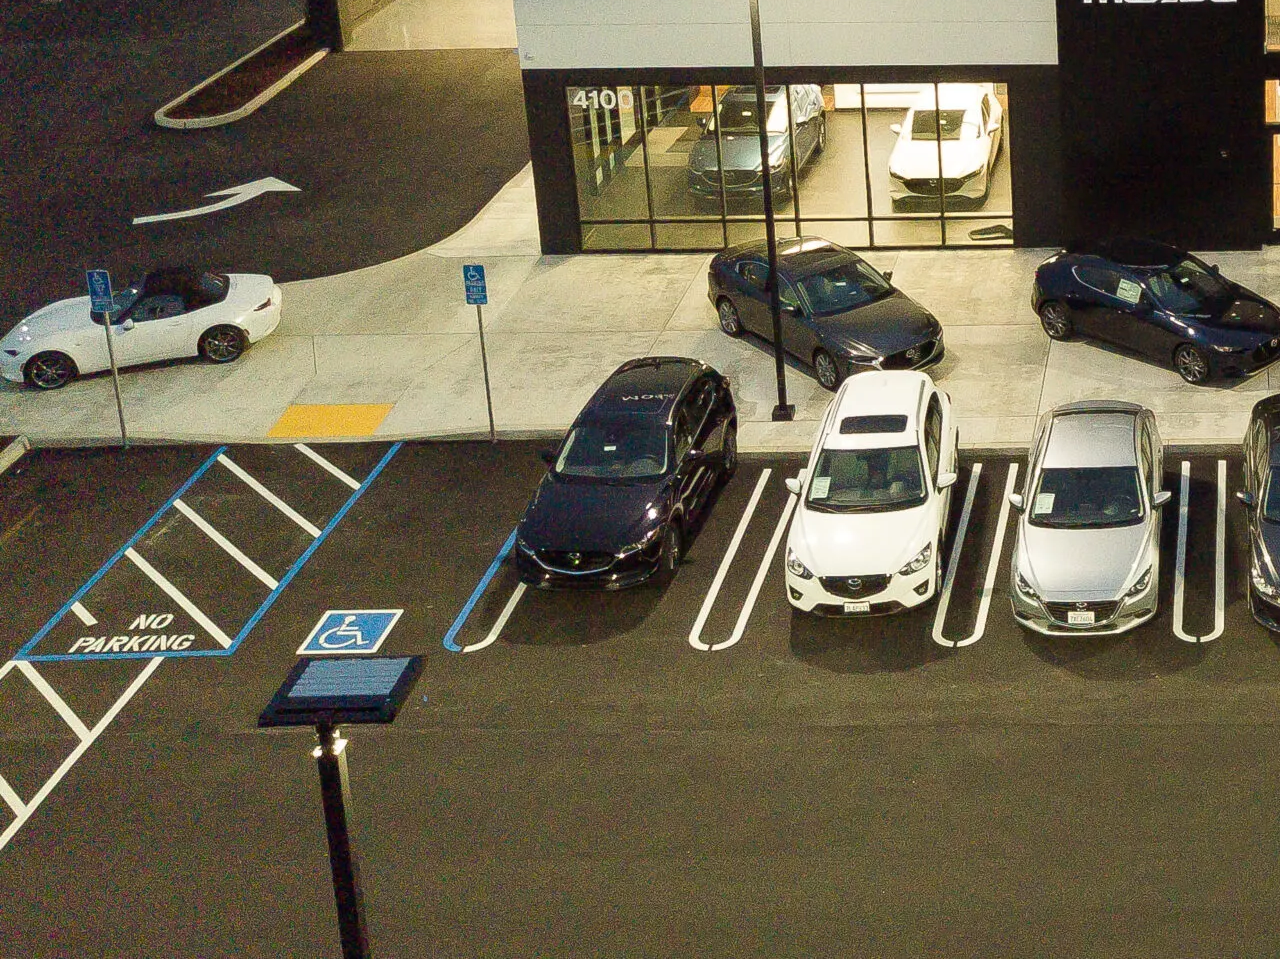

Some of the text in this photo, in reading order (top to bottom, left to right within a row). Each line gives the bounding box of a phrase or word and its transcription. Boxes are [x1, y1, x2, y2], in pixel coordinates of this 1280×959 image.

[573, 89, 634, 110] 4100
[127, 613, 175, 631] NO
[66, 634, 196, 654] PARKING
